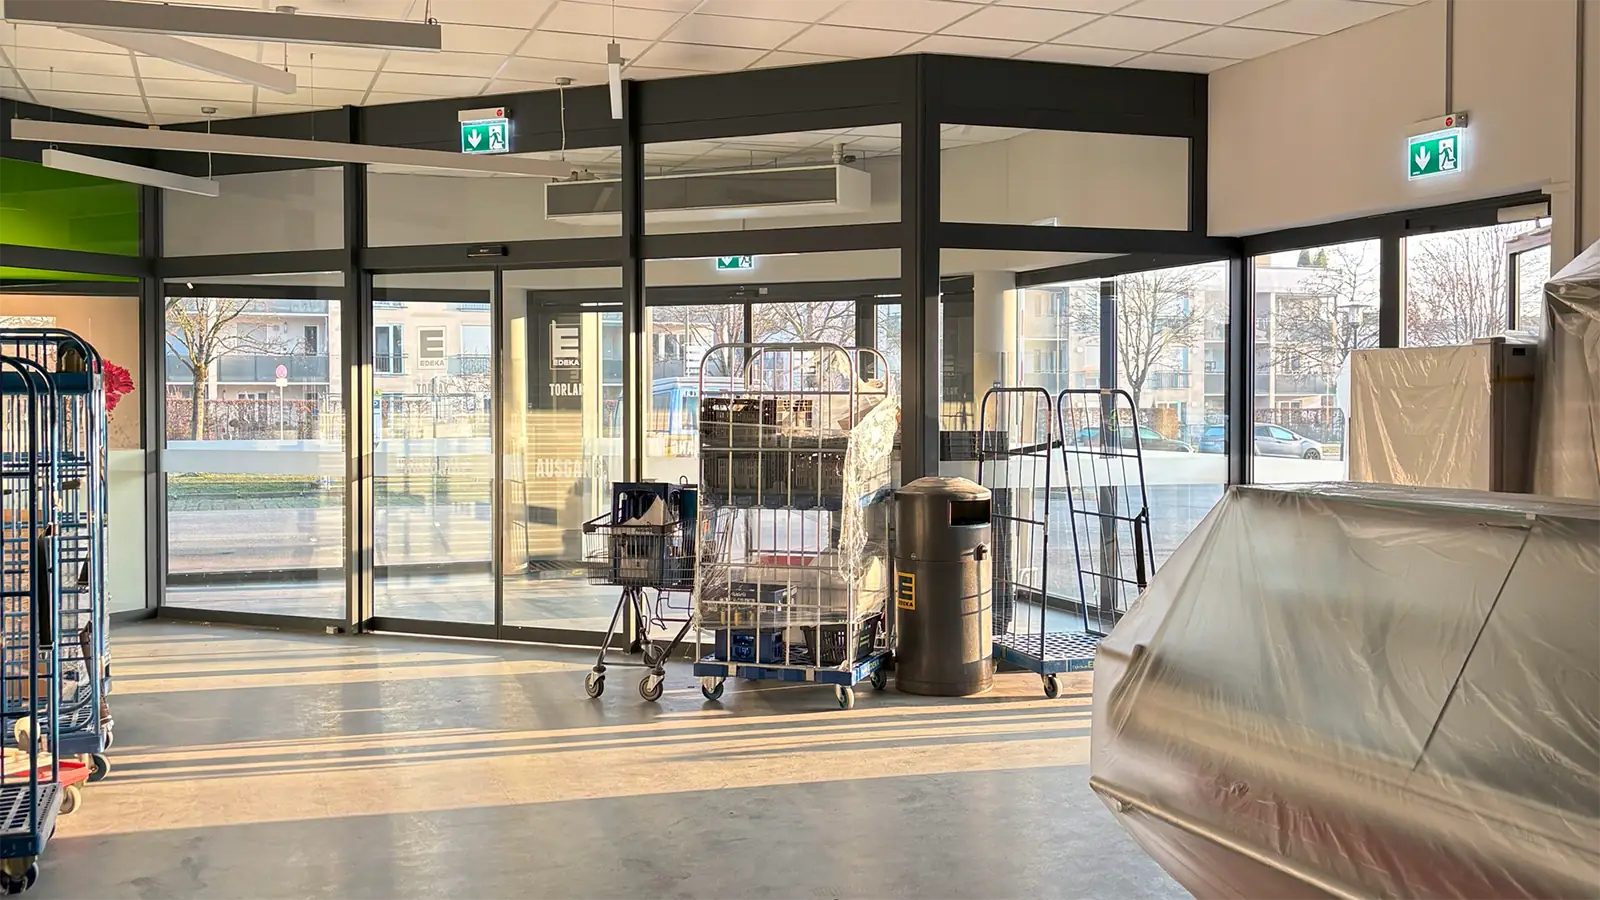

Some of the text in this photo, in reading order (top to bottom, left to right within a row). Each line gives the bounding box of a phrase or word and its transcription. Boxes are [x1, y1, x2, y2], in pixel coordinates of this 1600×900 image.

[420, 330, 443, 358] E
[552, 327, 579, 358] E
[537, 458, 601, 478] AUSGANG
